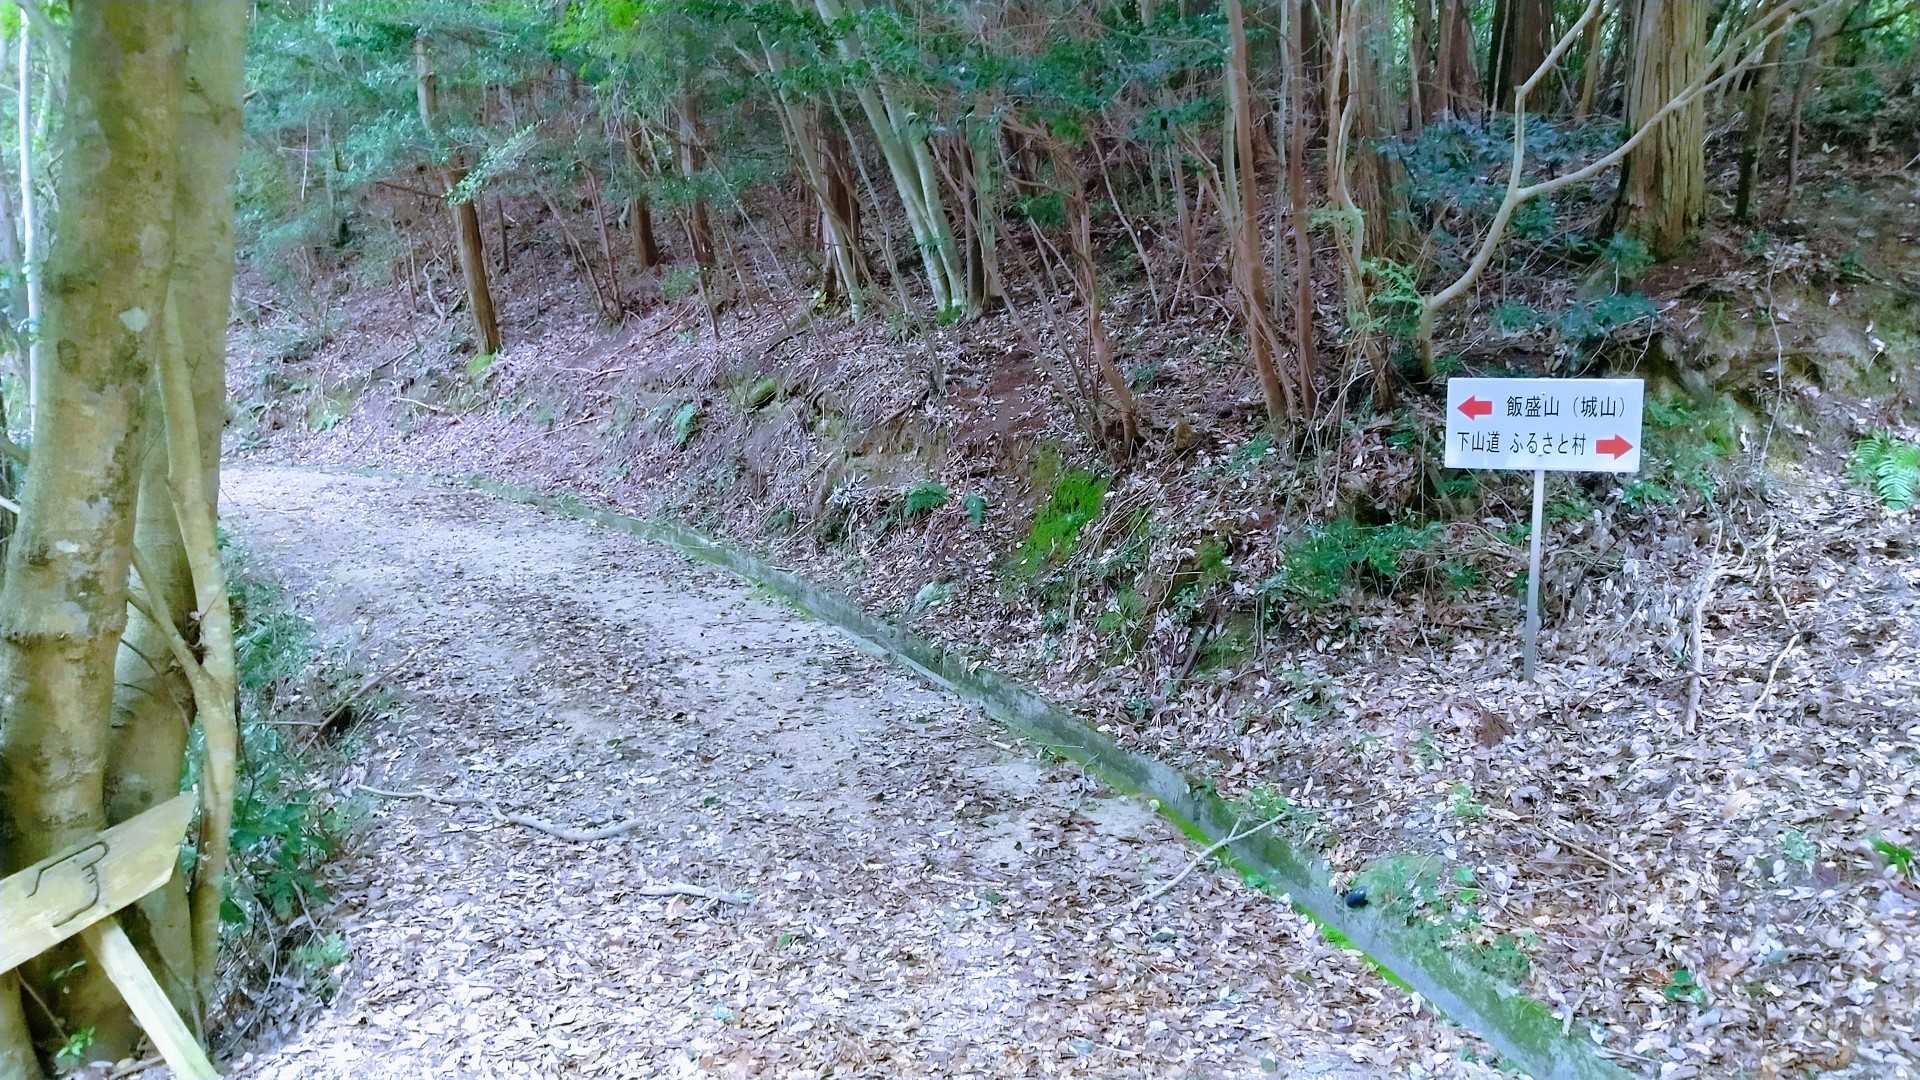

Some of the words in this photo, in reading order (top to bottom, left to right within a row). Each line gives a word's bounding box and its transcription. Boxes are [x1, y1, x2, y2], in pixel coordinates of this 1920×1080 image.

[1457, 431, 1500, 453] 下山道
[1510, 432, 1587, 456] ふるさと村
